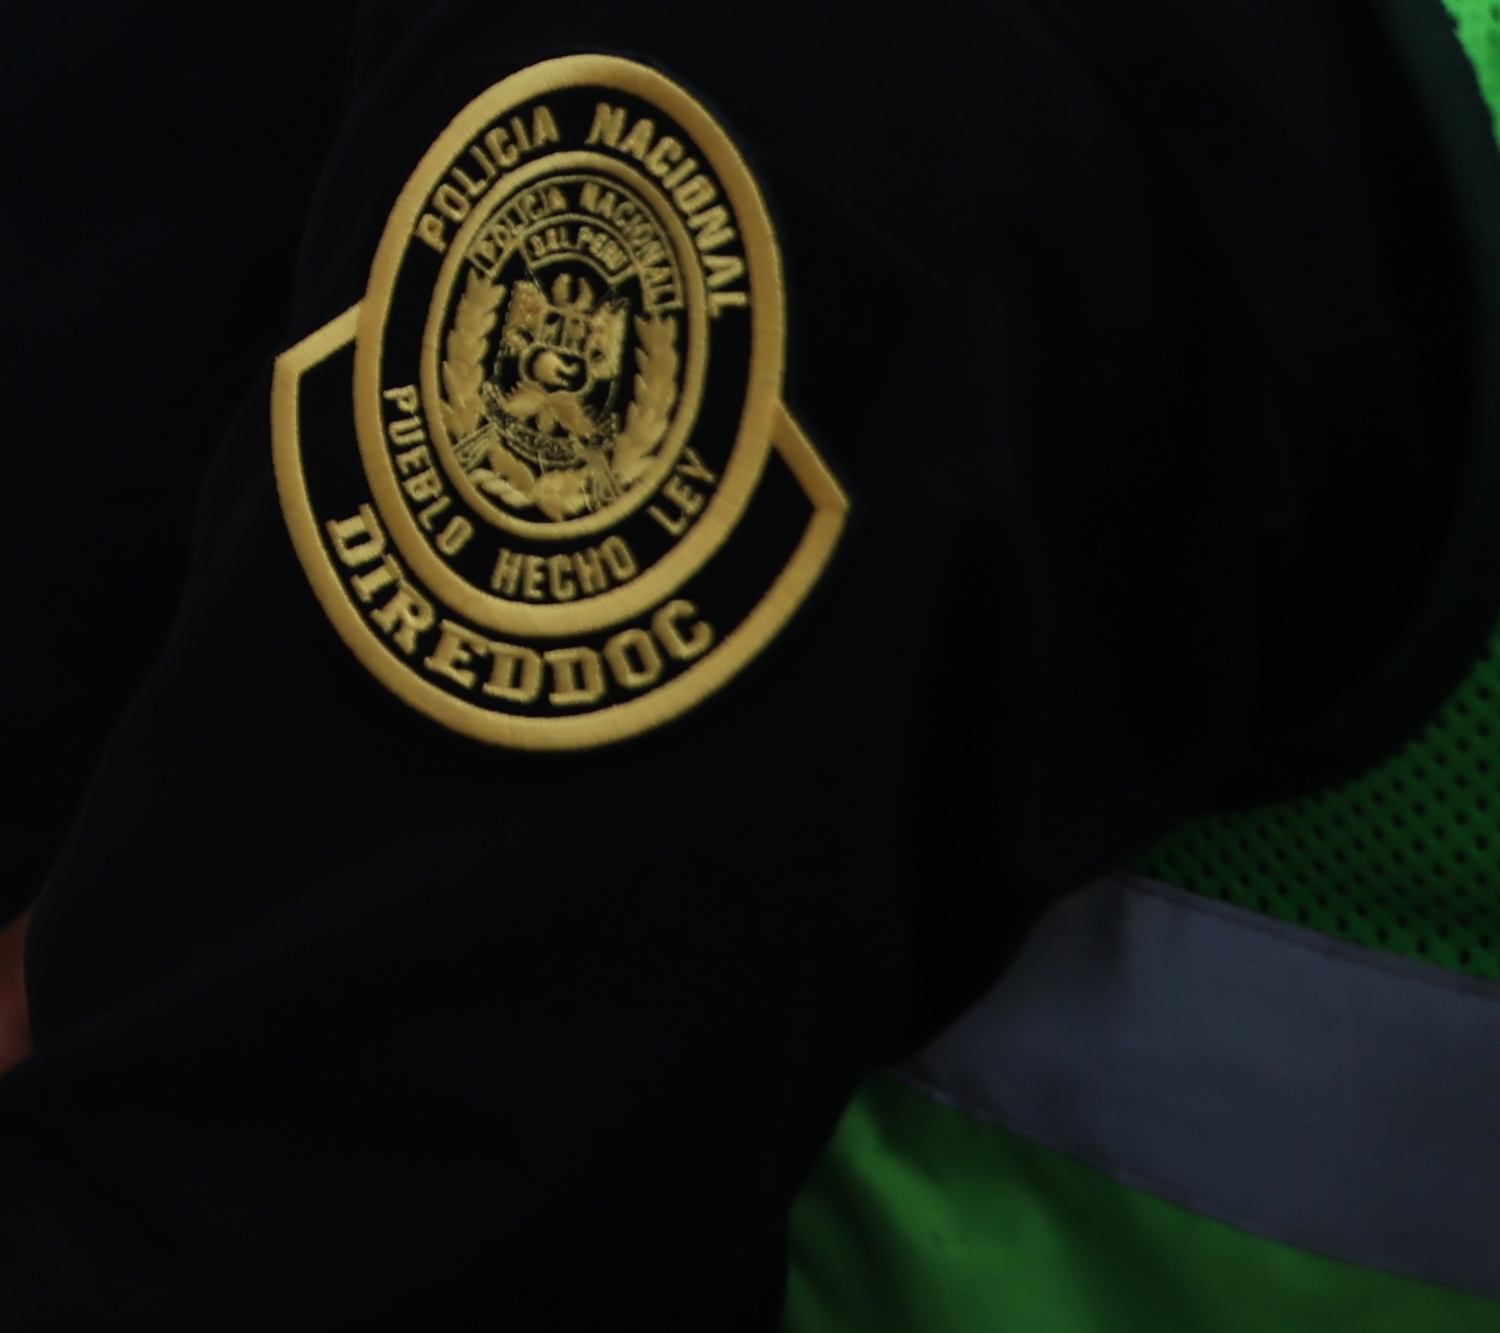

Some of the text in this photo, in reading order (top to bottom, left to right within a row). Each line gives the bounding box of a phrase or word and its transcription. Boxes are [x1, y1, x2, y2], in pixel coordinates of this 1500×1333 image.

[414, 102, 750, 319] POLICIA NACIONAL
[384, 383, 474, 557] PUEBLO
[492, 536, 638, 602] HECHO
[646, 447, 719, 536] LEY
[327, 504, 713, 705] DIREDDOC
